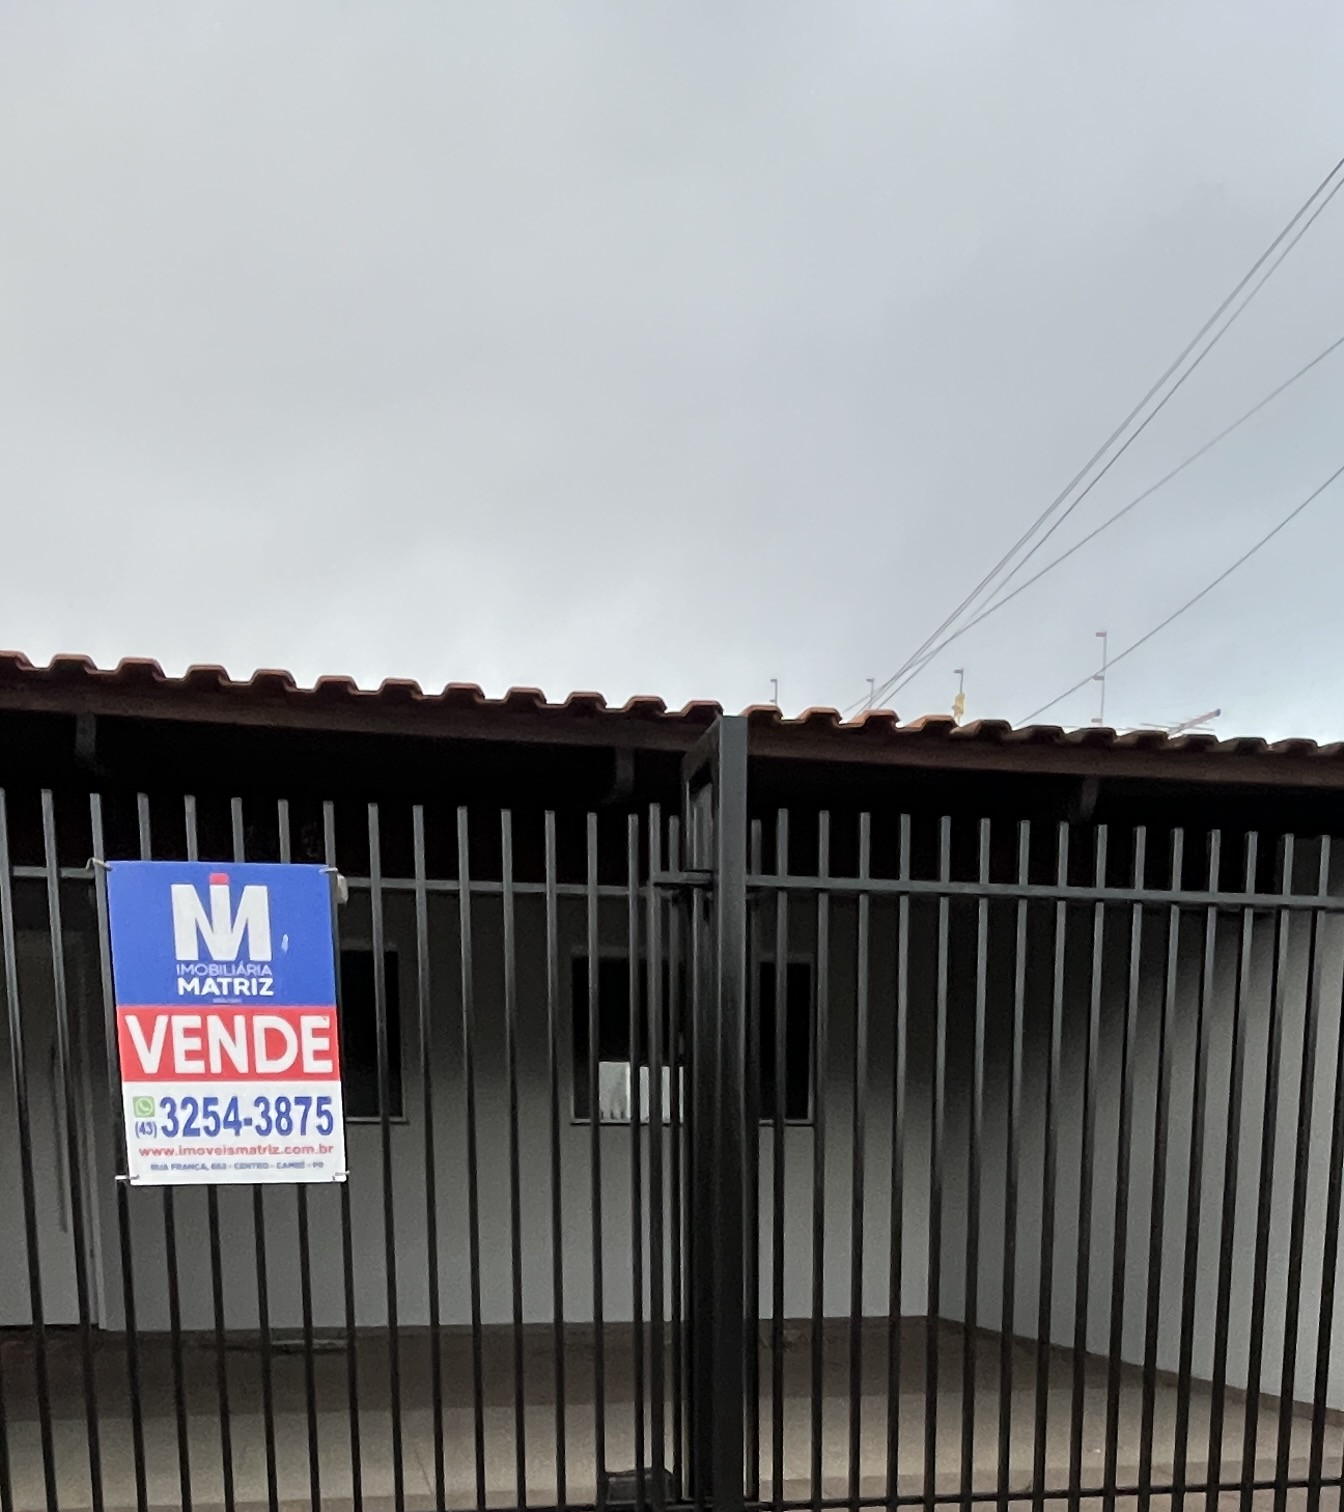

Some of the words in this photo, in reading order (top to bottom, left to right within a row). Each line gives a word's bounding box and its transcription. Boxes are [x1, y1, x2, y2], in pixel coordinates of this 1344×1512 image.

[176, 960, 273, 977] IMOBILIÁRIA
[178, 977, 274, 996] MATRIZ
[125, 1014, 333, 1074] VENDE
[135, 1121, 157, 1139] (43)
[159, 1095, 334, 1137] 3254-3875
[138, 1144, 334, 1156] www.imoveismatriz.com.br
